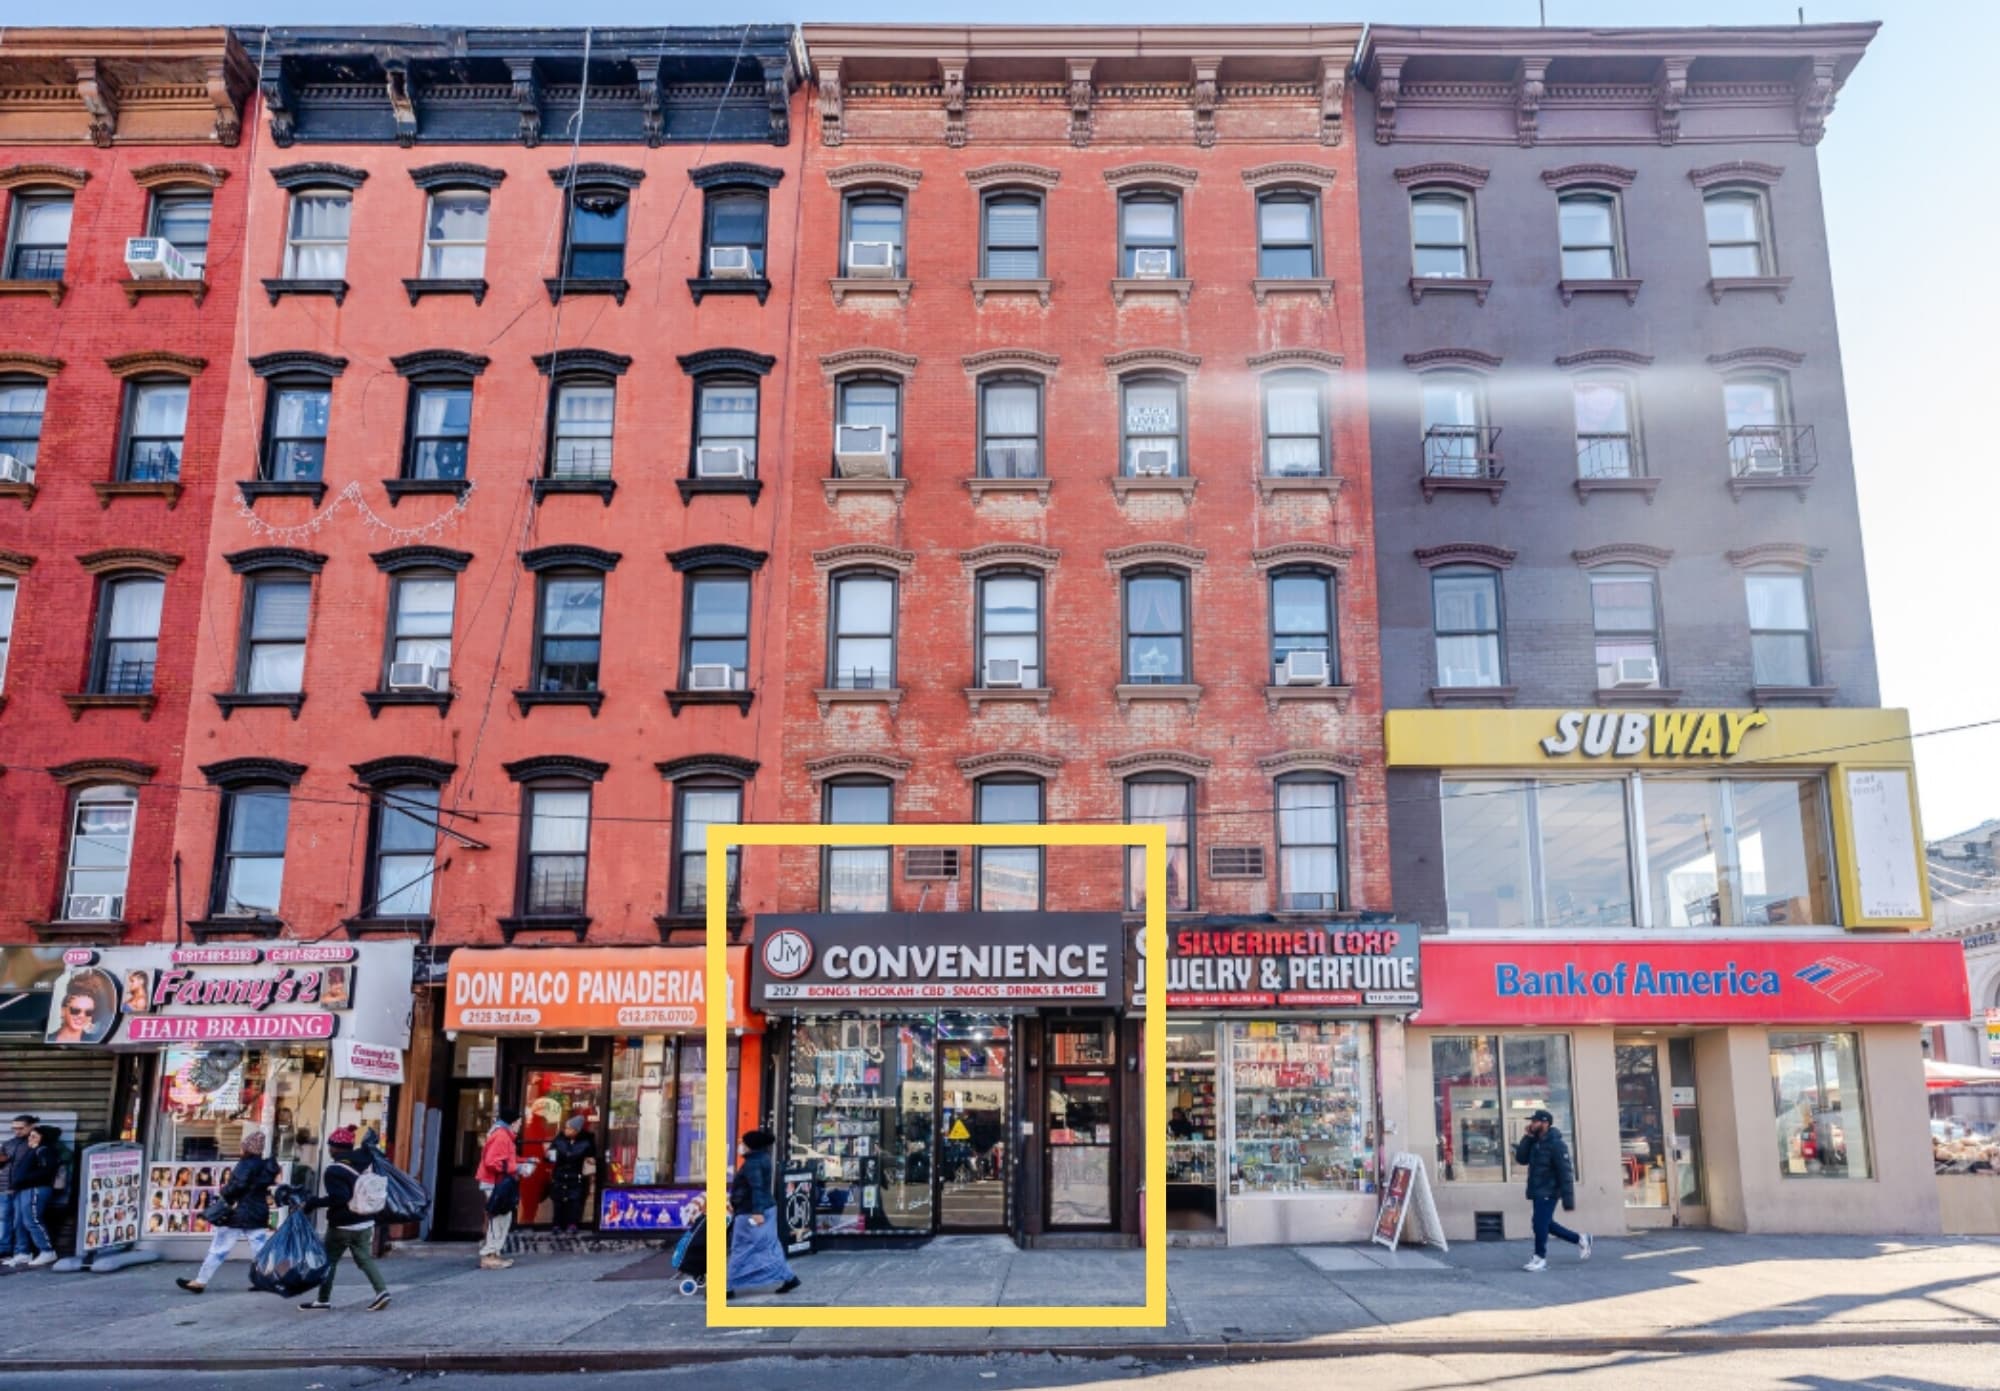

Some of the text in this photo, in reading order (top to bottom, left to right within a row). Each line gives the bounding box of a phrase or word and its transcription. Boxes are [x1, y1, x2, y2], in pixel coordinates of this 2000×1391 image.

[1540, 709, 1769, 756] SUBWAY
[1177, 930, 1401, 956] SILVERMEN CORP
[822, 944, 1109, 979] CONVENIENCE
[1133, 955, 1416, 991] JWELRY & PERFUME
[153, 968, 320, 1010] Fanny's 2
[454, 970, 705, 1006] DON PACO PANADERIA
[772, 983, 1098, 997] 2127 BONGS HOOKAH CBD SNACKS DRINKS & MORE
[1494, 962, 1781, 996] Bank of America
[138, 1016, 323, 1038] HAIR BRAIDING
[495, 1010, 511, 1023] 3rd
